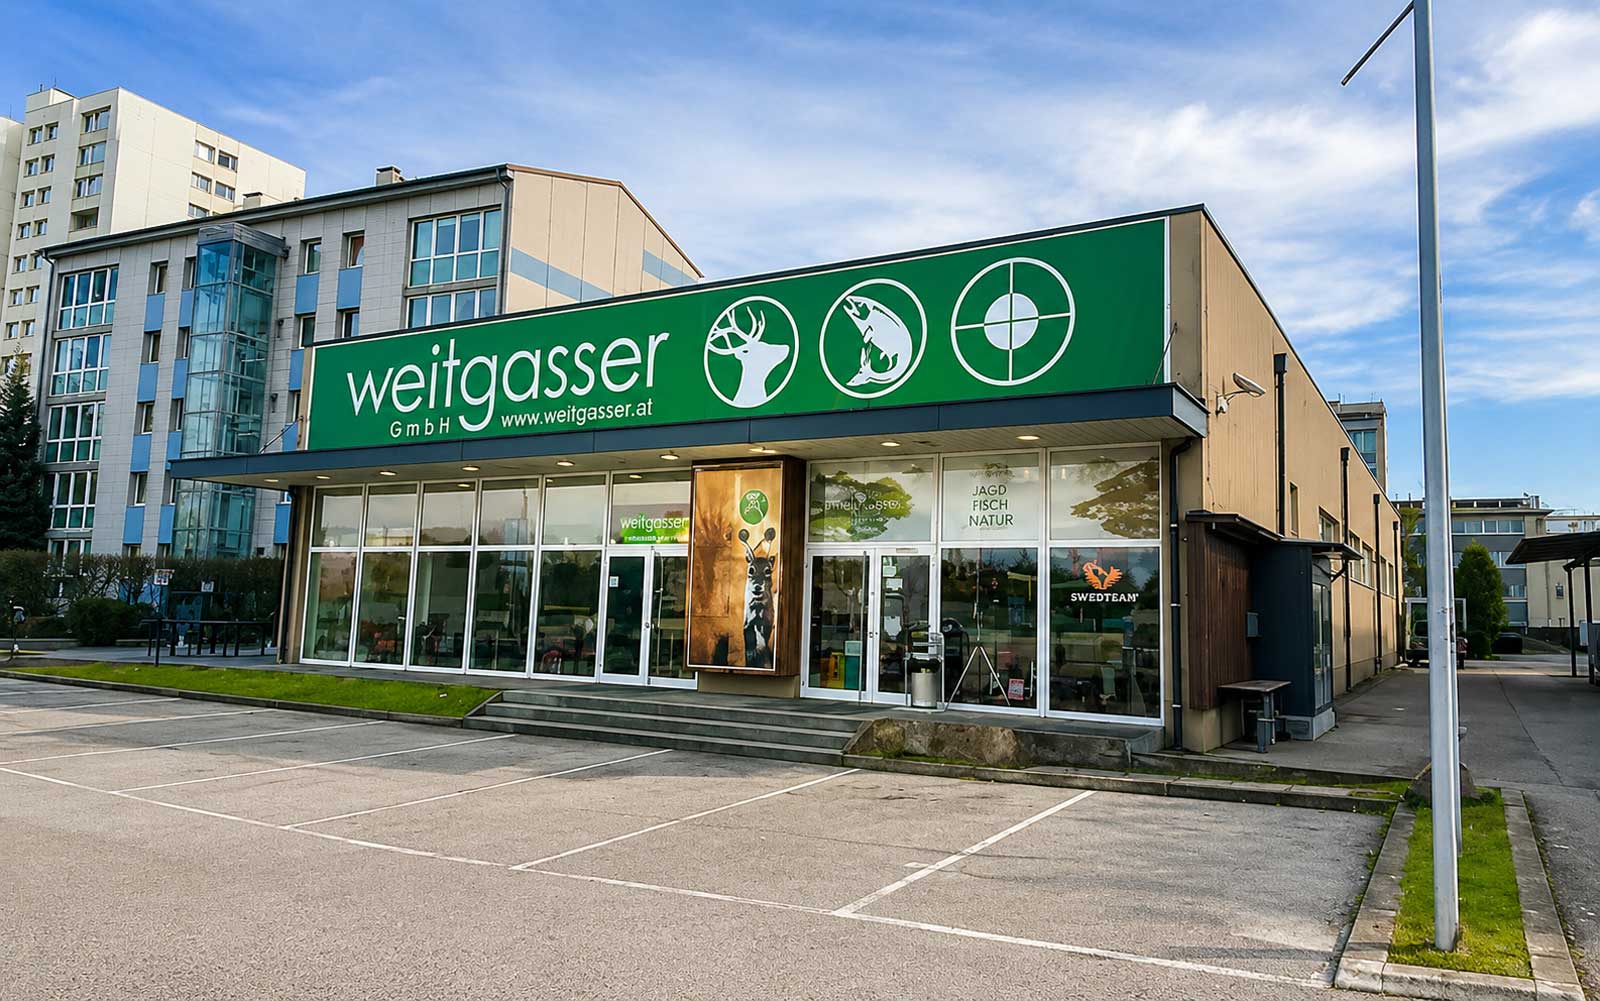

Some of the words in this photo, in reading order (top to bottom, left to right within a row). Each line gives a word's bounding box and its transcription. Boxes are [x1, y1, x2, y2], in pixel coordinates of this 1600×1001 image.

[347, 332, 670, 432] weitgasser
[501, 398, 653, 428] www.weitgasser.at
[972, 485, 1007, 496] JAGD
[972, 499, 1008, 511] FISCH
[620, 515, 689, 533] weitgasser
[968, 514, 1014, 527] NATUR
[1070, 592, 1137, 603] SWEDTEAM
